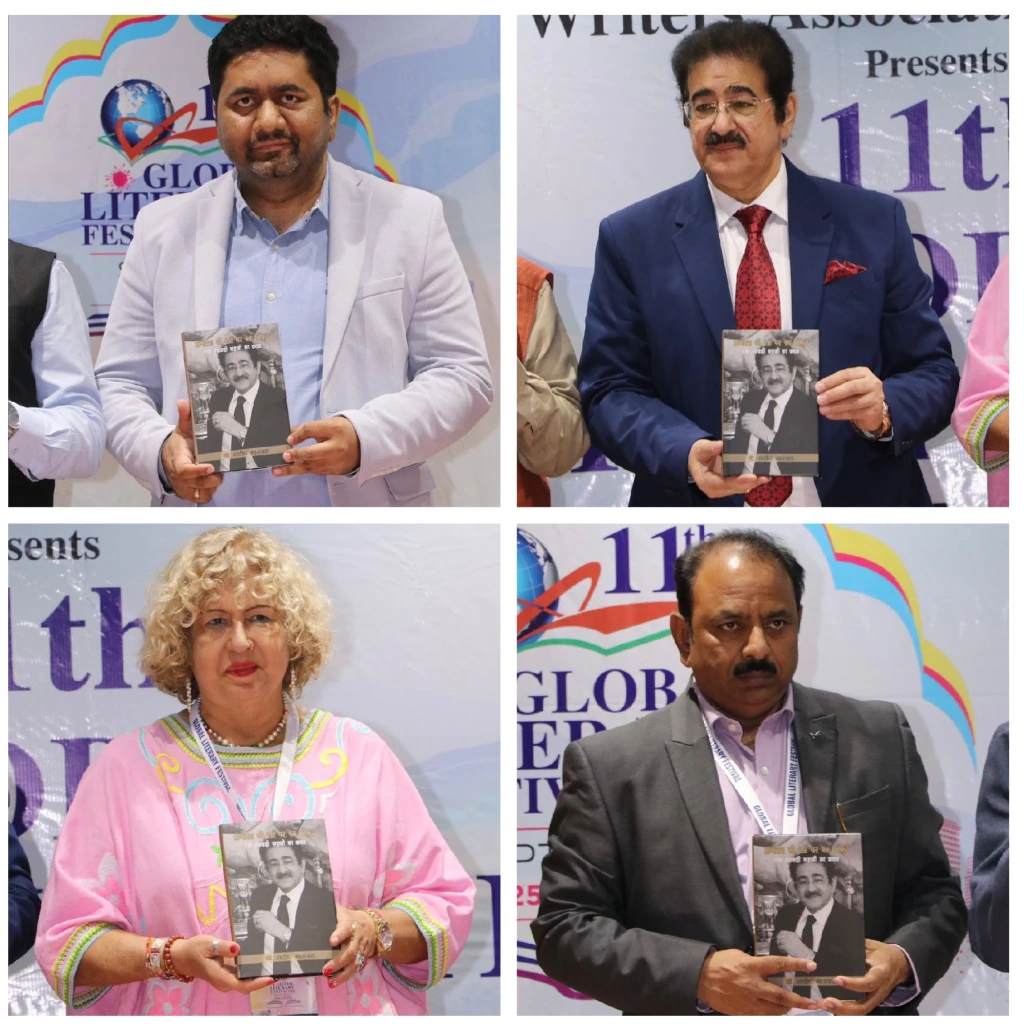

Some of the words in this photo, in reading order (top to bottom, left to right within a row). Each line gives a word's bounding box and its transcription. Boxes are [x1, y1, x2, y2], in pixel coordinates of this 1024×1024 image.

[865, 47, 1008, 78] Presents
[8, 530, 101, 561] sents
[517, 668, 678, 715] GLOB
[200, 739, 219, 766] LITERARY
[788, 763, 798, 790] LITERARY
[754, 804, 770, 828] GLOBAL
[786, 793, 796, 817] GLOBAL
